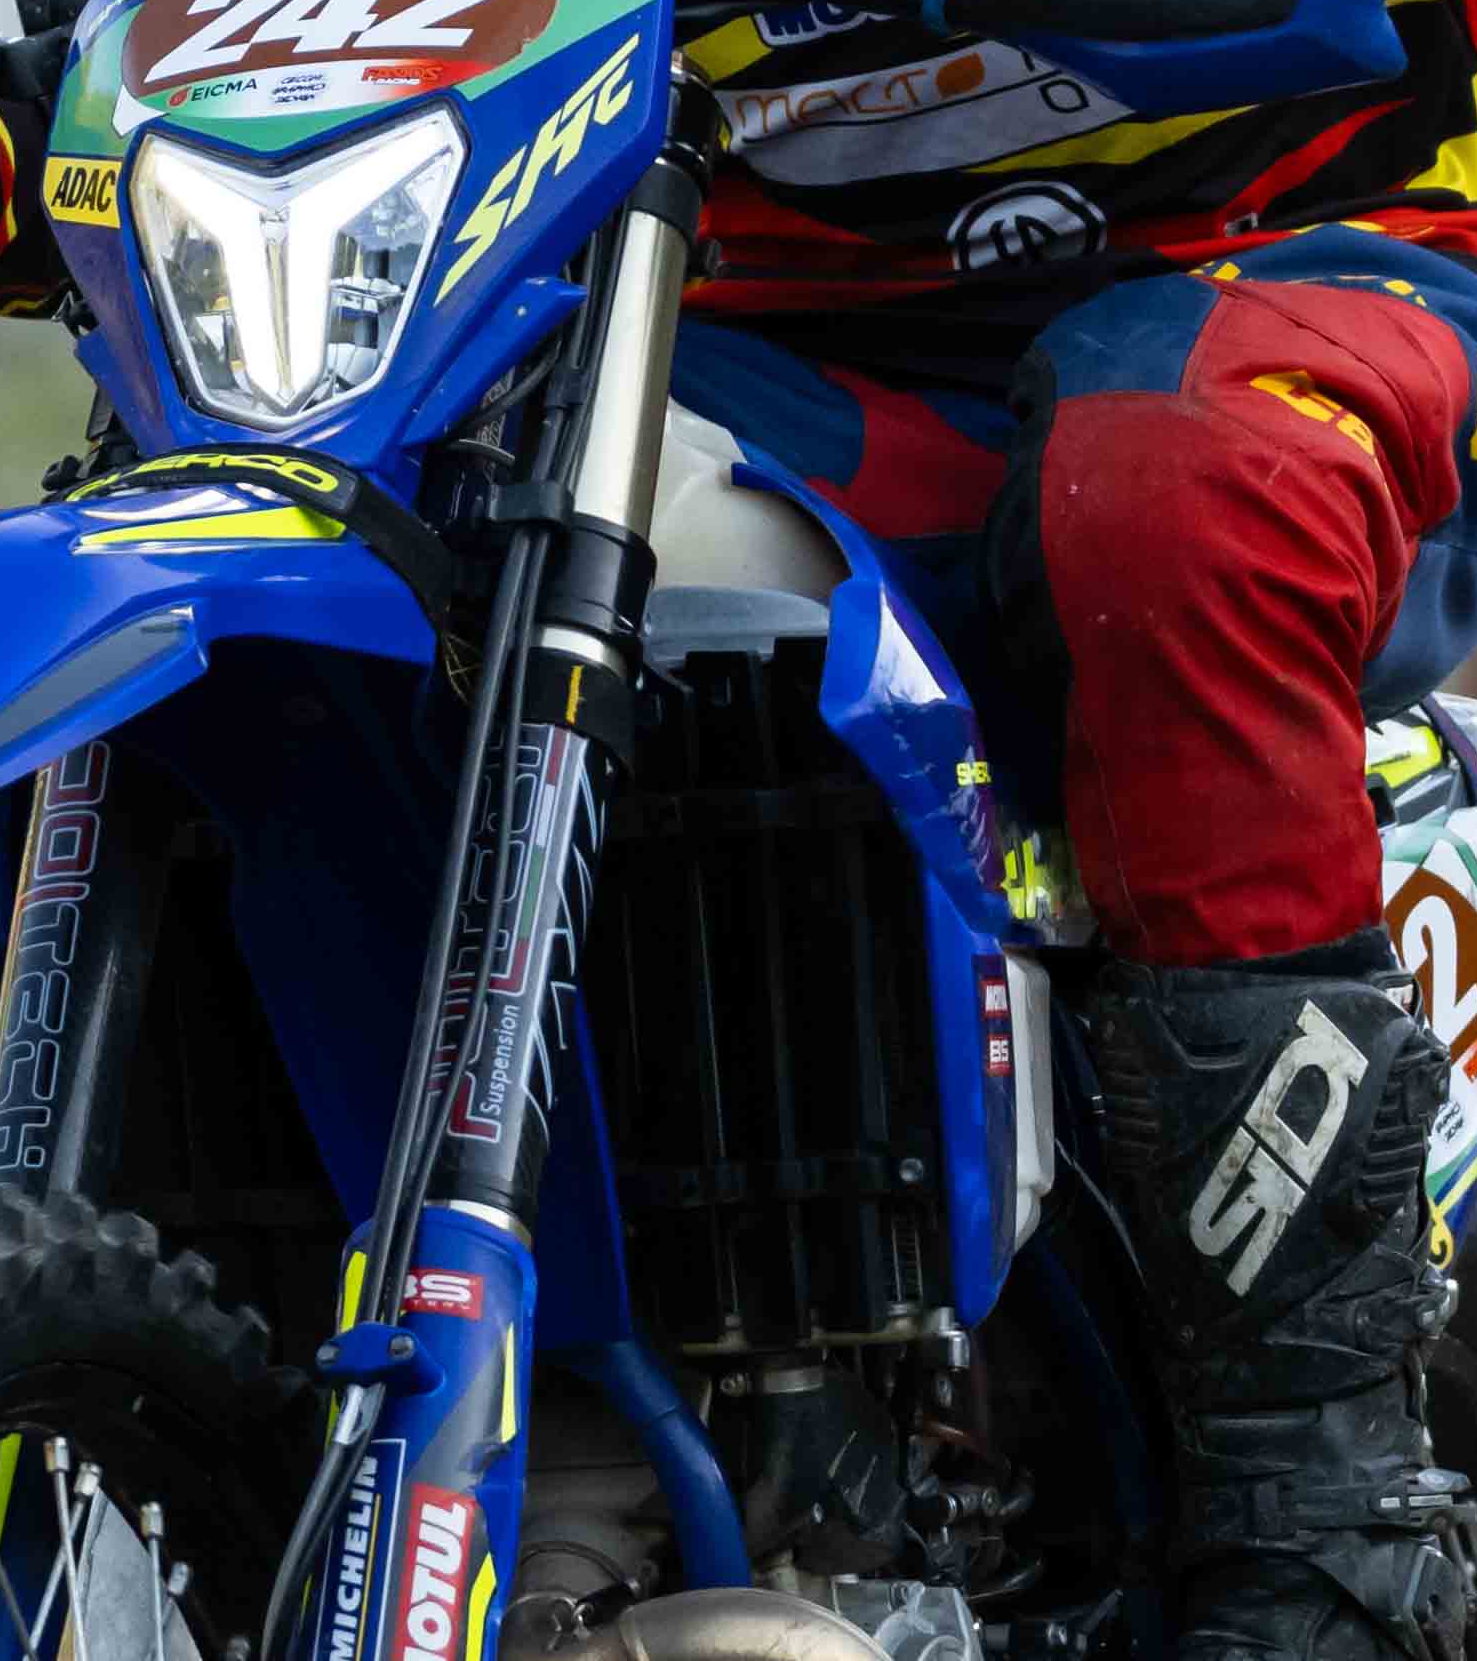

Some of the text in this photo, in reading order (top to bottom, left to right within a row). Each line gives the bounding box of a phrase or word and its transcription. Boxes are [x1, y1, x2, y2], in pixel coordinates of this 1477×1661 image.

[190, 77, 258, 103] EICMA
[51, 165, 116, 213] ADAC
[478, 1002, 522, 1117] Suspension
